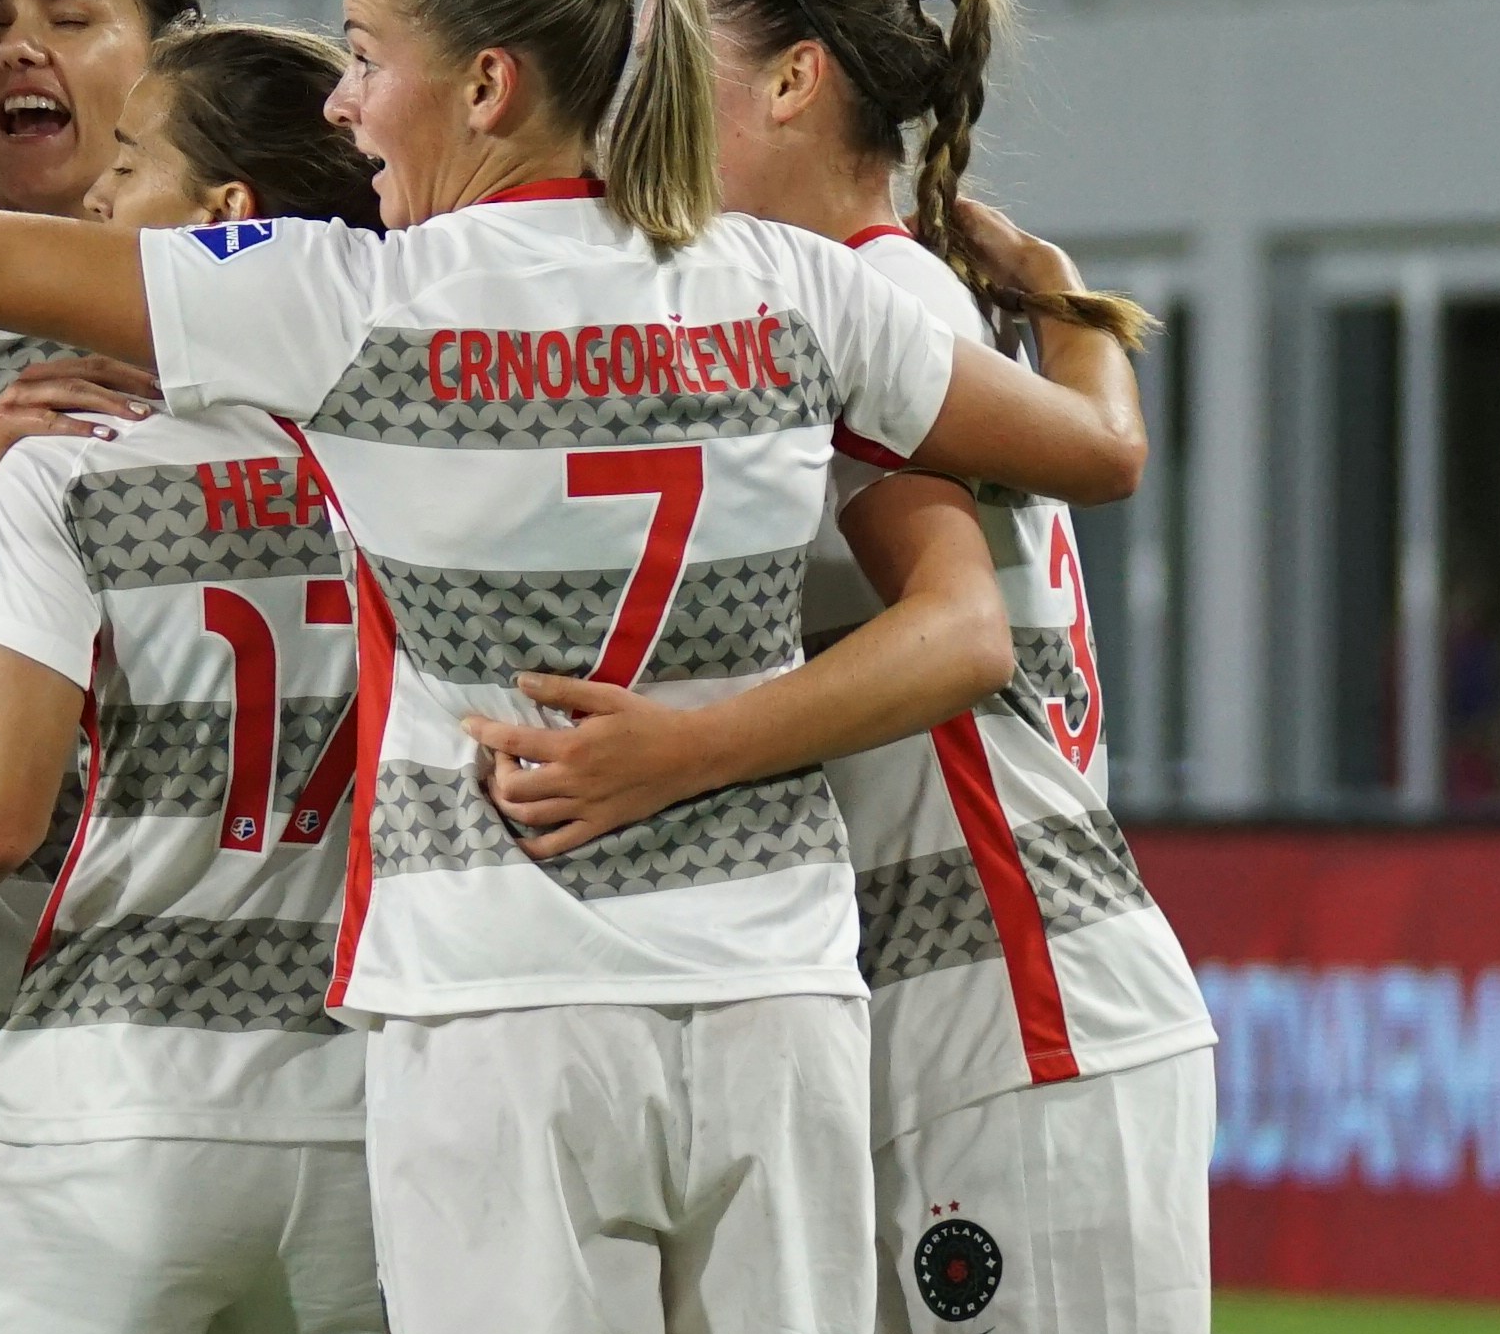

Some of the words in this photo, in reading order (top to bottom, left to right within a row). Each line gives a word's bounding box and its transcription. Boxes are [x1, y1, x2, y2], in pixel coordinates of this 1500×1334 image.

[565, 445, 705, 720] 7
[1044, 511, 1102, 775] 3
[202, 578, 359, 855] 17
[920, 1226, 993, 1266] PORTLAND
[928, 1275, 997, 1316] THORNS
